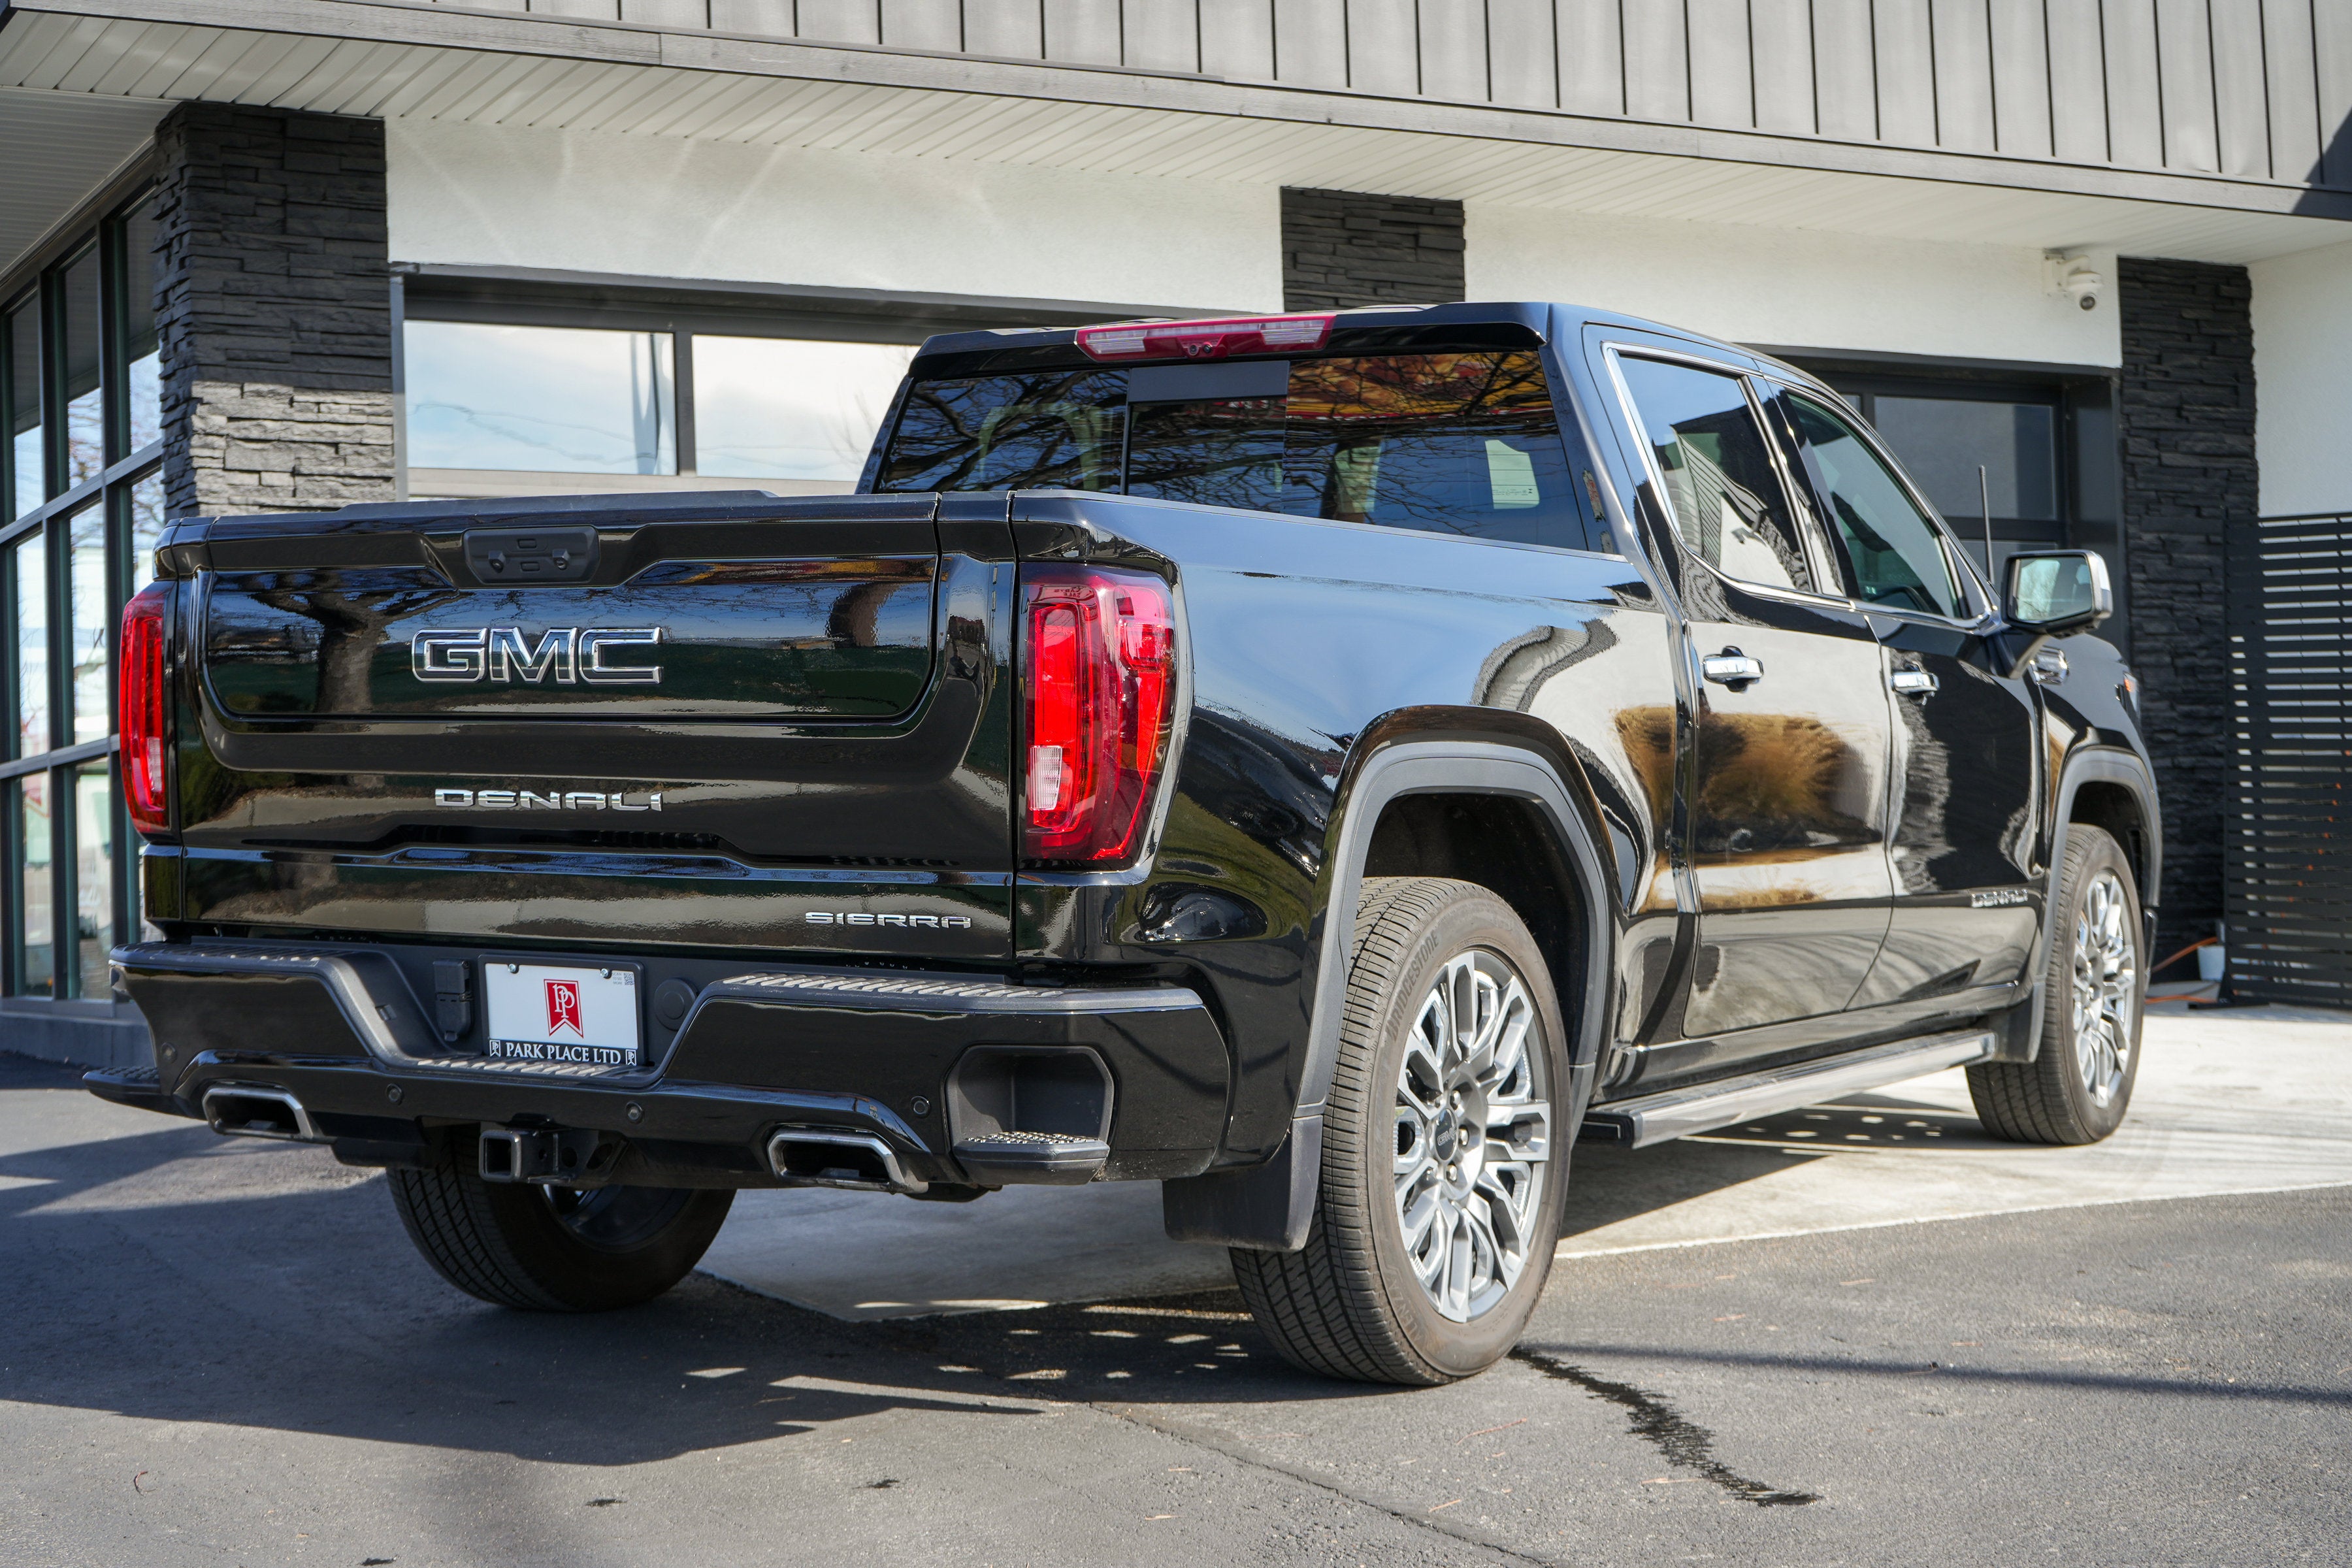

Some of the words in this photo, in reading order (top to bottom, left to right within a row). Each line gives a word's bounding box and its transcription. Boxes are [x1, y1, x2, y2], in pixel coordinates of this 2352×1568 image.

[412, 627, 664, 685] GMC
[434, 789, 662, 812] DENALI
[805, 911, 972, 929] SIERRA
[1385, 929, 1439, 1042] BRIDGESTONE
[506, 1042, 544, 1059] PARK
[547, 1045, 589, 1062] PLACE
[593, 1048, 621, 1064] LTD
